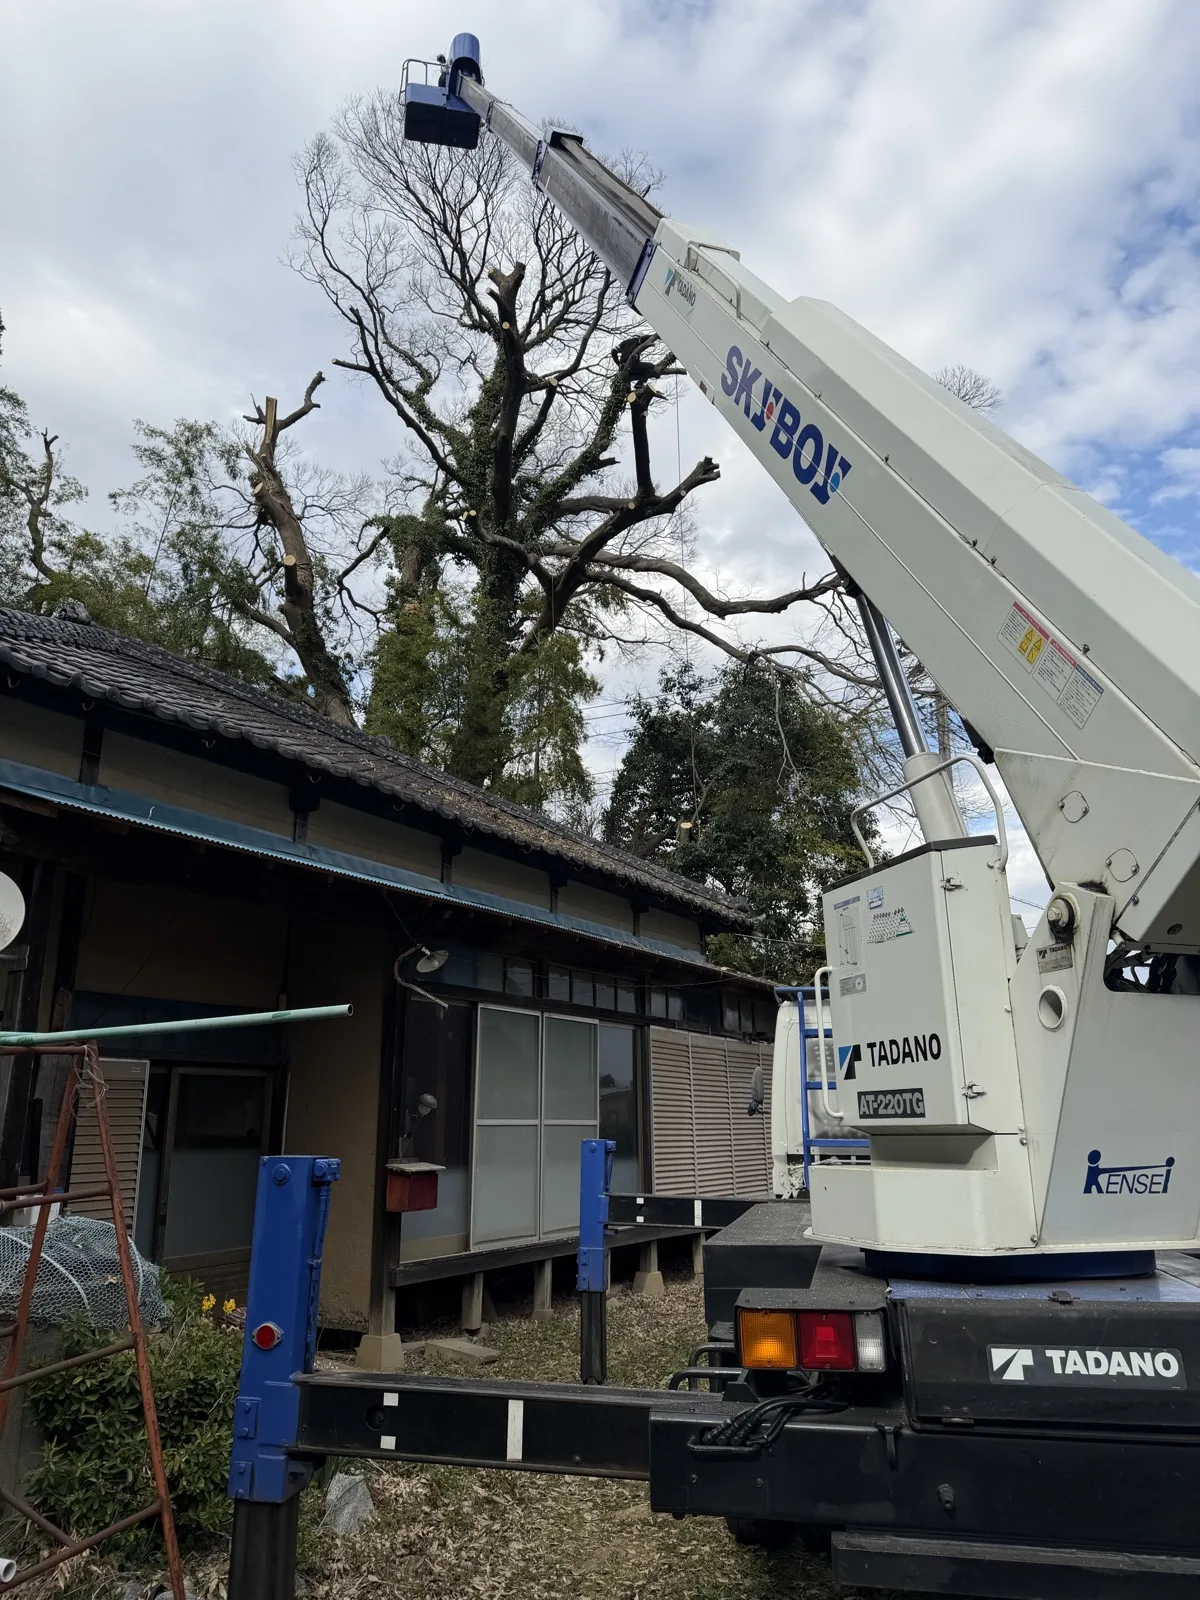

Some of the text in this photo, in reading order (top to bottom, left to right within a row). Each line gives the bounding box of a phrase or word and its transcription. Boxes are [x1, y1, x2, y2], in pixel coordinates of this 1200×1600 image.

[677, 277, 697, 307] TADANO
[721, 345, 852, 505] SKYBOY
[867, 1033, 942, 1067] TADANO
[858, 1090, 925, 1116] AT-220TG
[1083, 1149, 1175, 1195] KENSEI
[1045, 1350, 1179, 1378] TADANO
